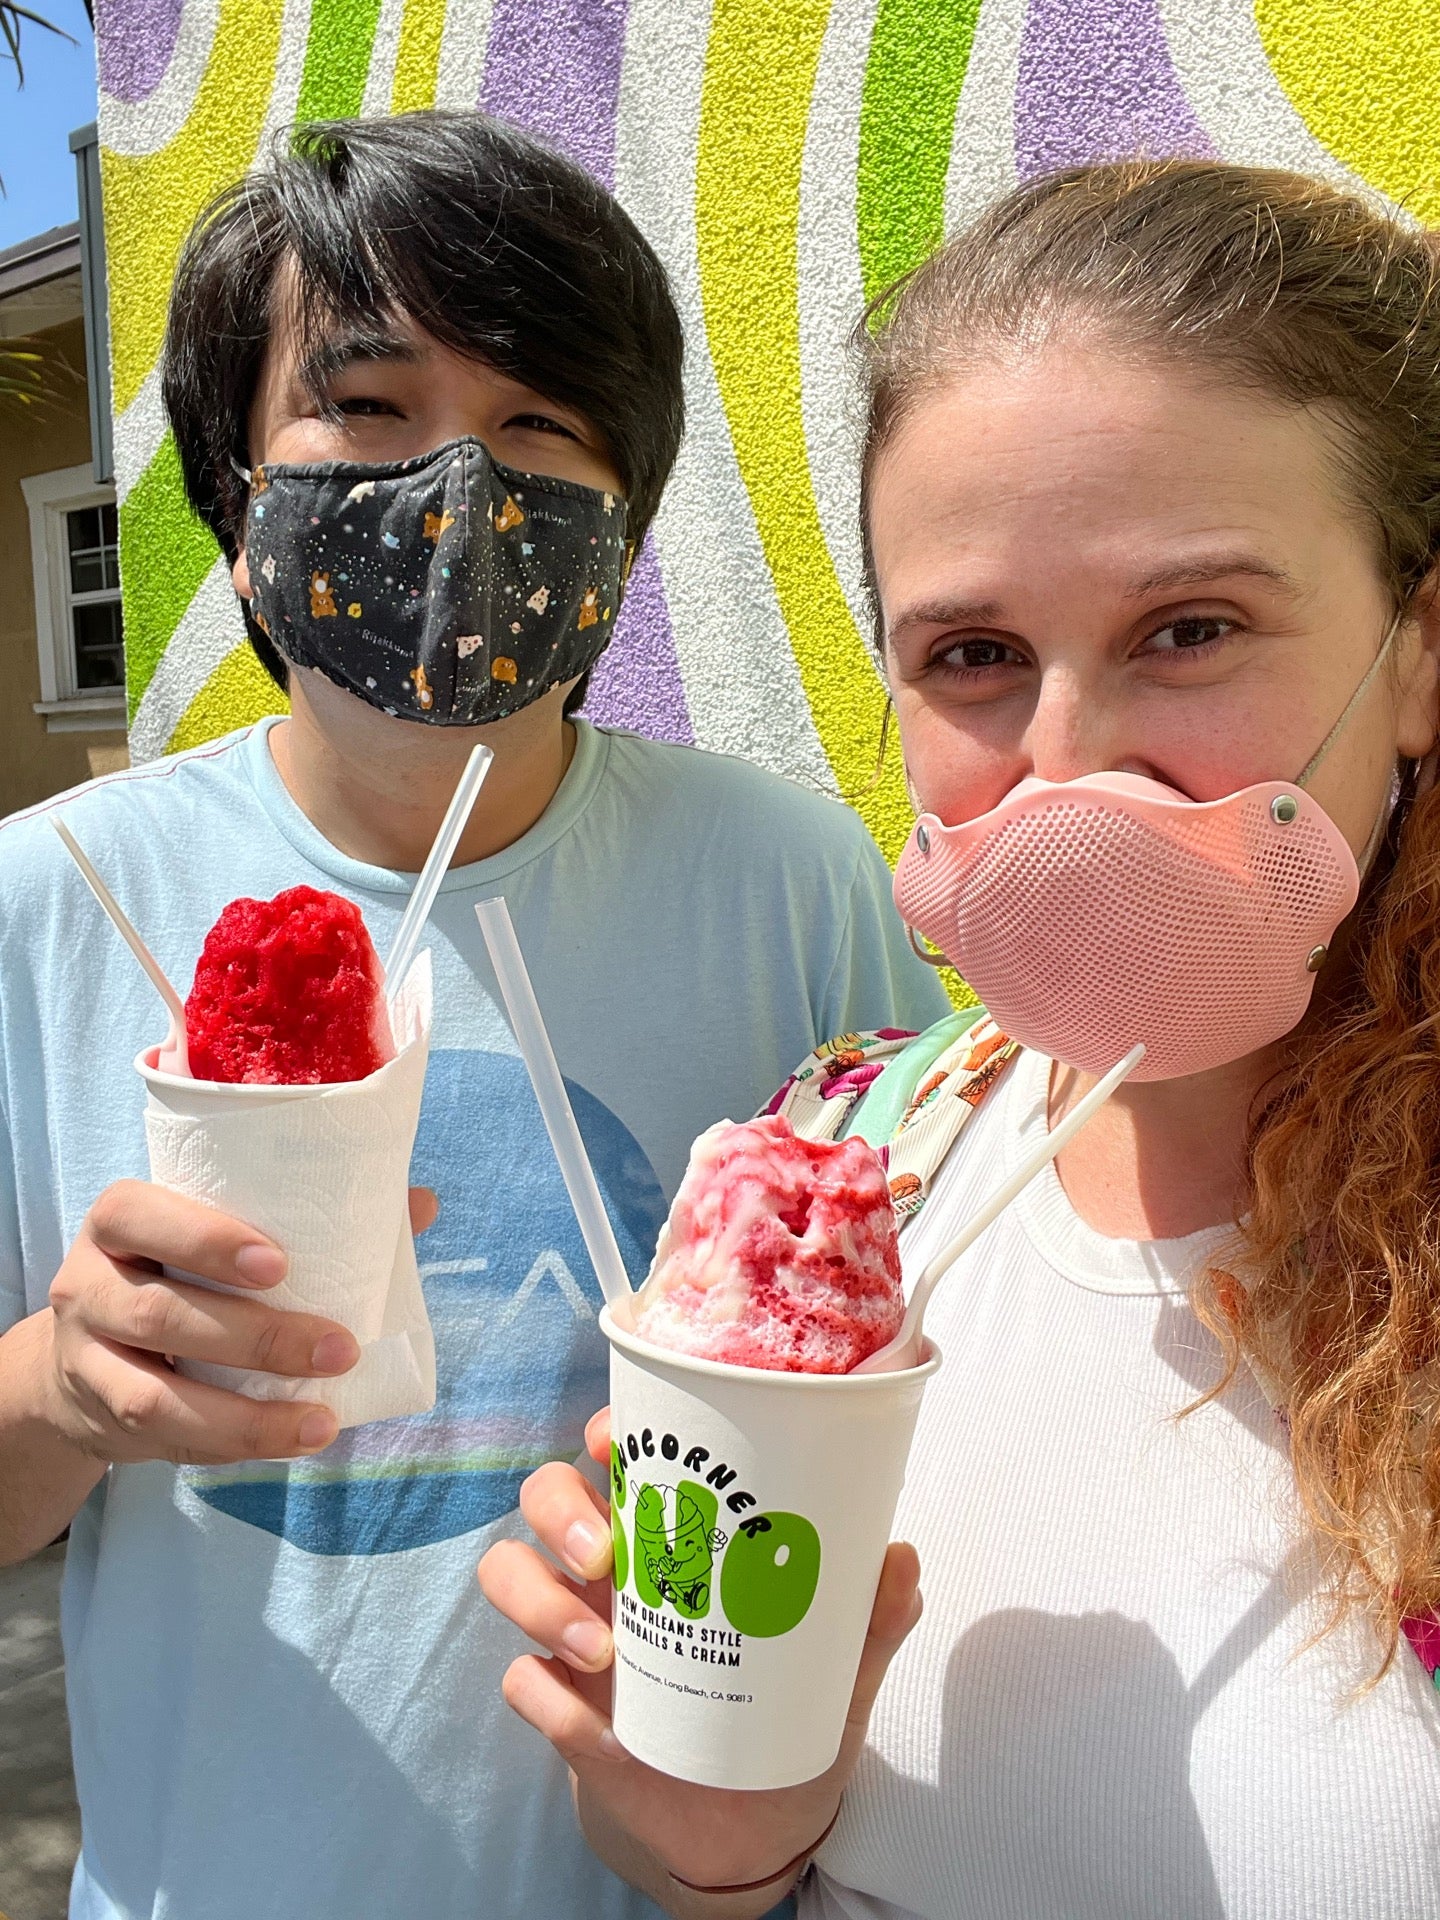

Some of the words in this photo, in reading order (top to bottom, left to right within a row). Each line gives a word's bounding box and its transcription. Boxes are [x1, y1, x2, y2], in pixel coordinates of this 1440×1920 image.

[621, 1592, 638, 1616] NEW
[641, 1607, 694, 1639] ORLEANS
[700, 1628, 743, 1648] STYLE
[621, 1611, 668, 1650] SNOBALLS
[674, 1641, 684, 1657] &
[691, 1645, 741, 1667] CREAM
[664, 1678, 683, 1693] Long
[684, 1684, 709, 1699] Beach,
[710, 1691, 724, 1701] CA
[726, 1693, 753, 1703] 90813
